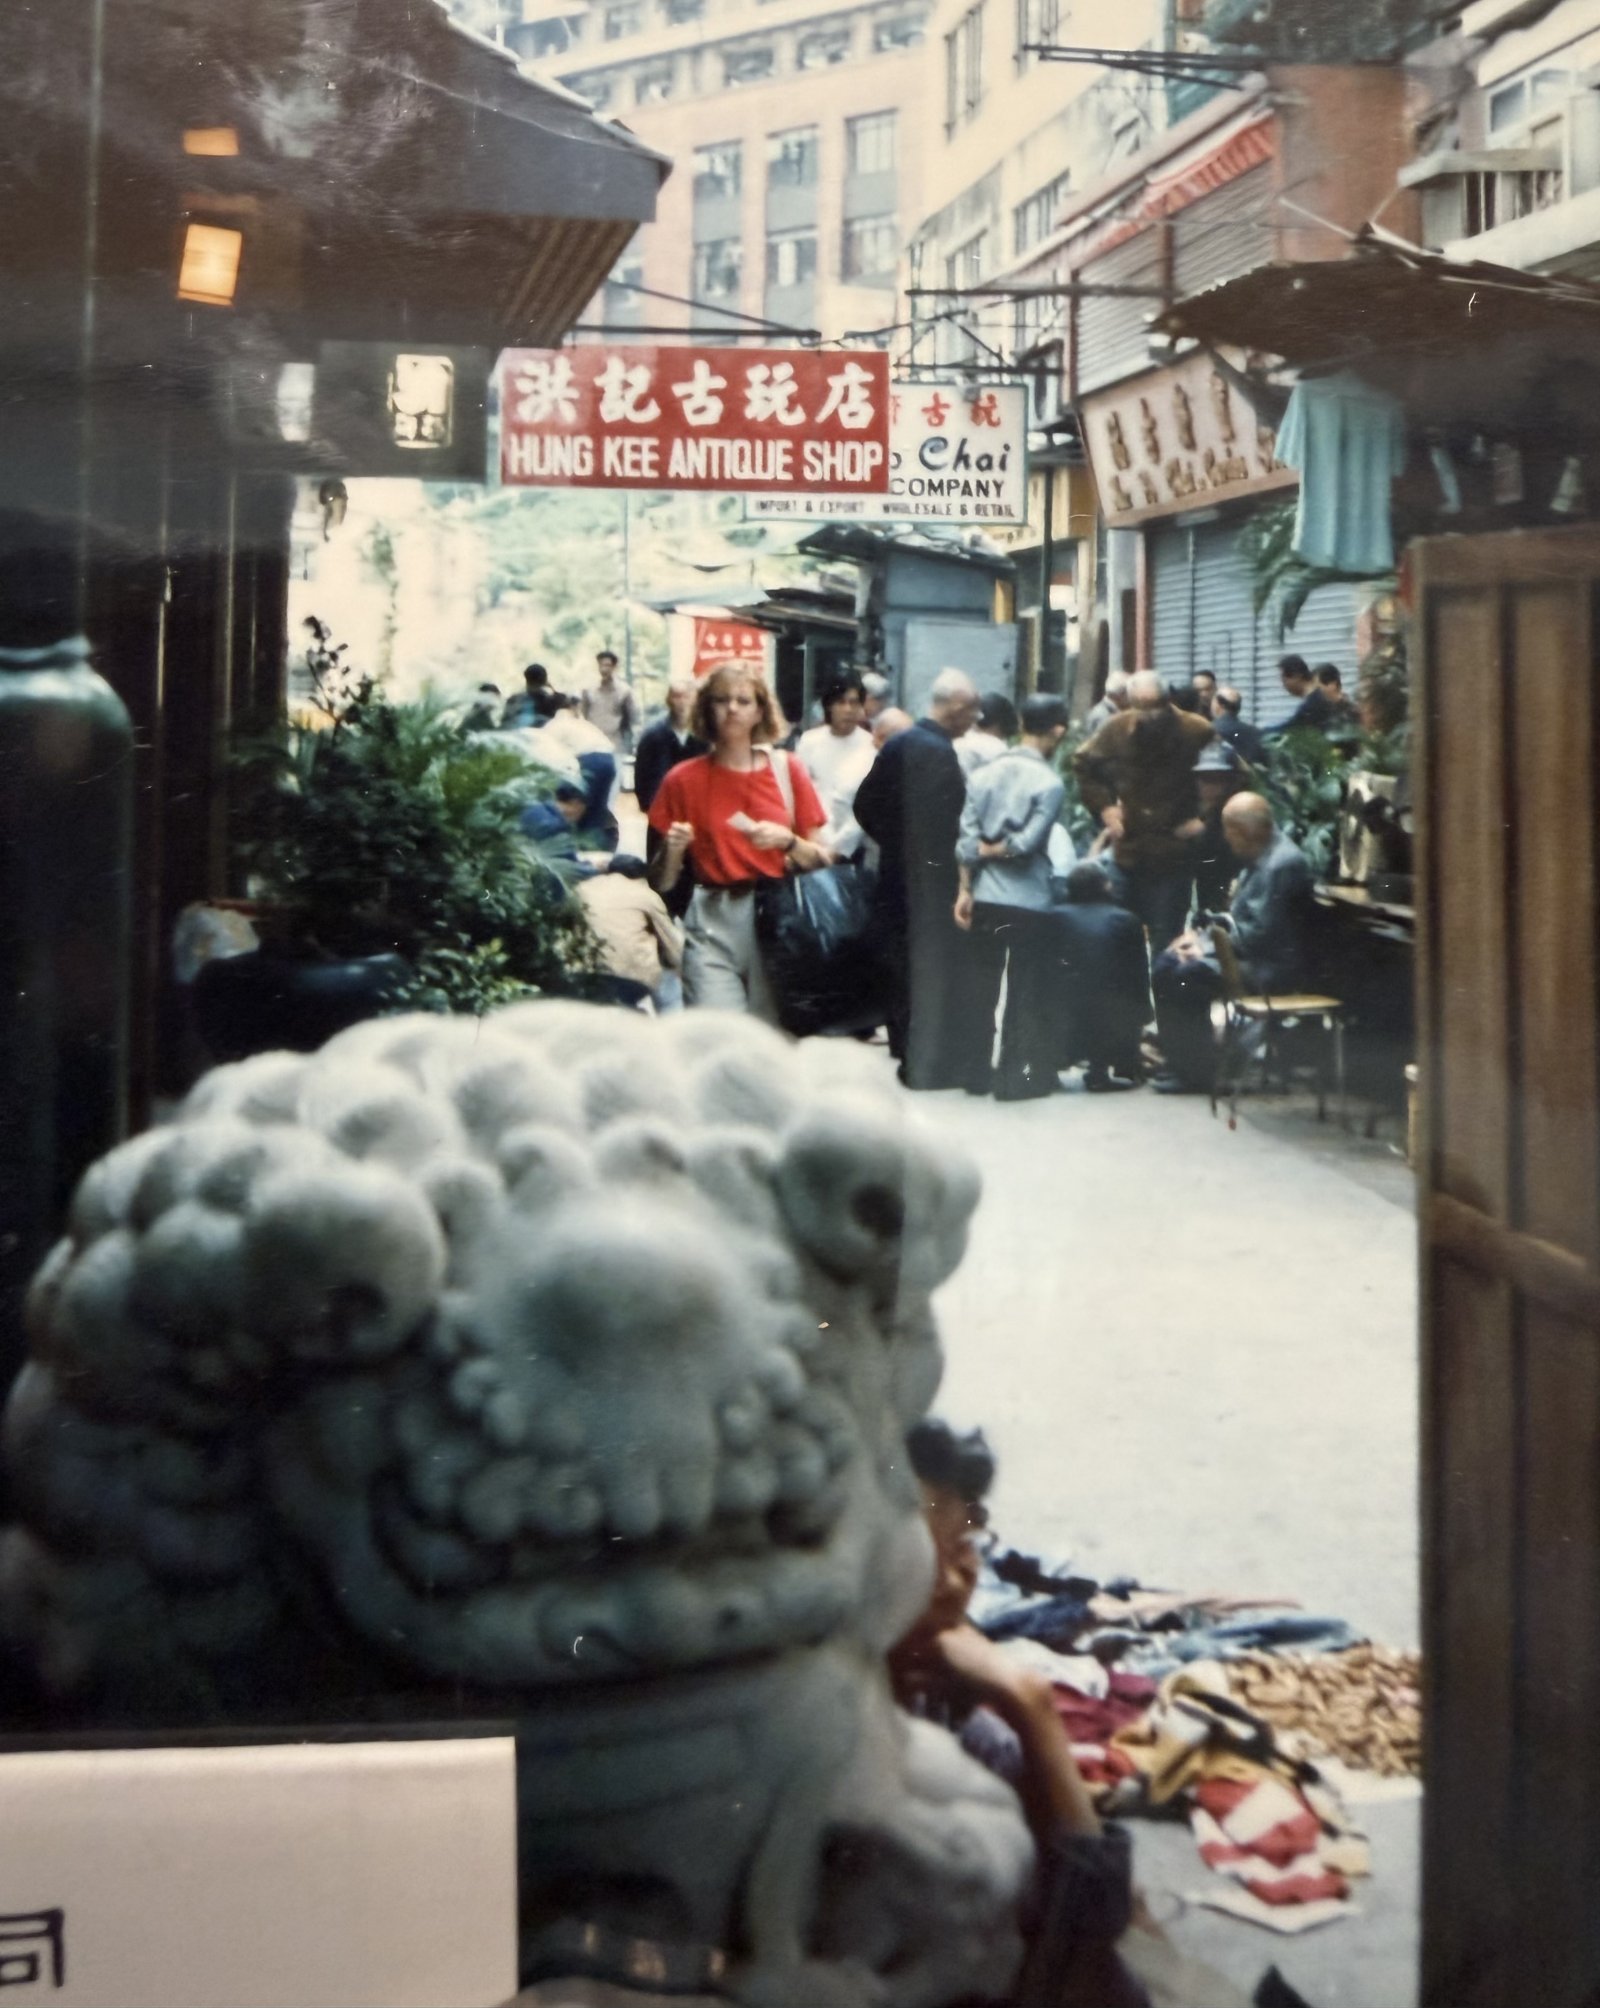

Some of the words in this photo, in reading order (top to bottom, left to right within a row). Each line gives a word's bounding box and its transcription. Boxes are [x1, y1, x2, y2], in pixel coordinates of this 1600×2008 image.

[514, 355, 876, 429] 洪記古玩店
[510, 433, 593, 477] HUNG
[603, 435, 660, 478] KEE
[668, 437, 793, 481] ANTIQUE
[803, 440, 883, 482] SHOP
[918, 435, 1011, 472] Chai
[889, 478, 1004, 498] COMPANY
